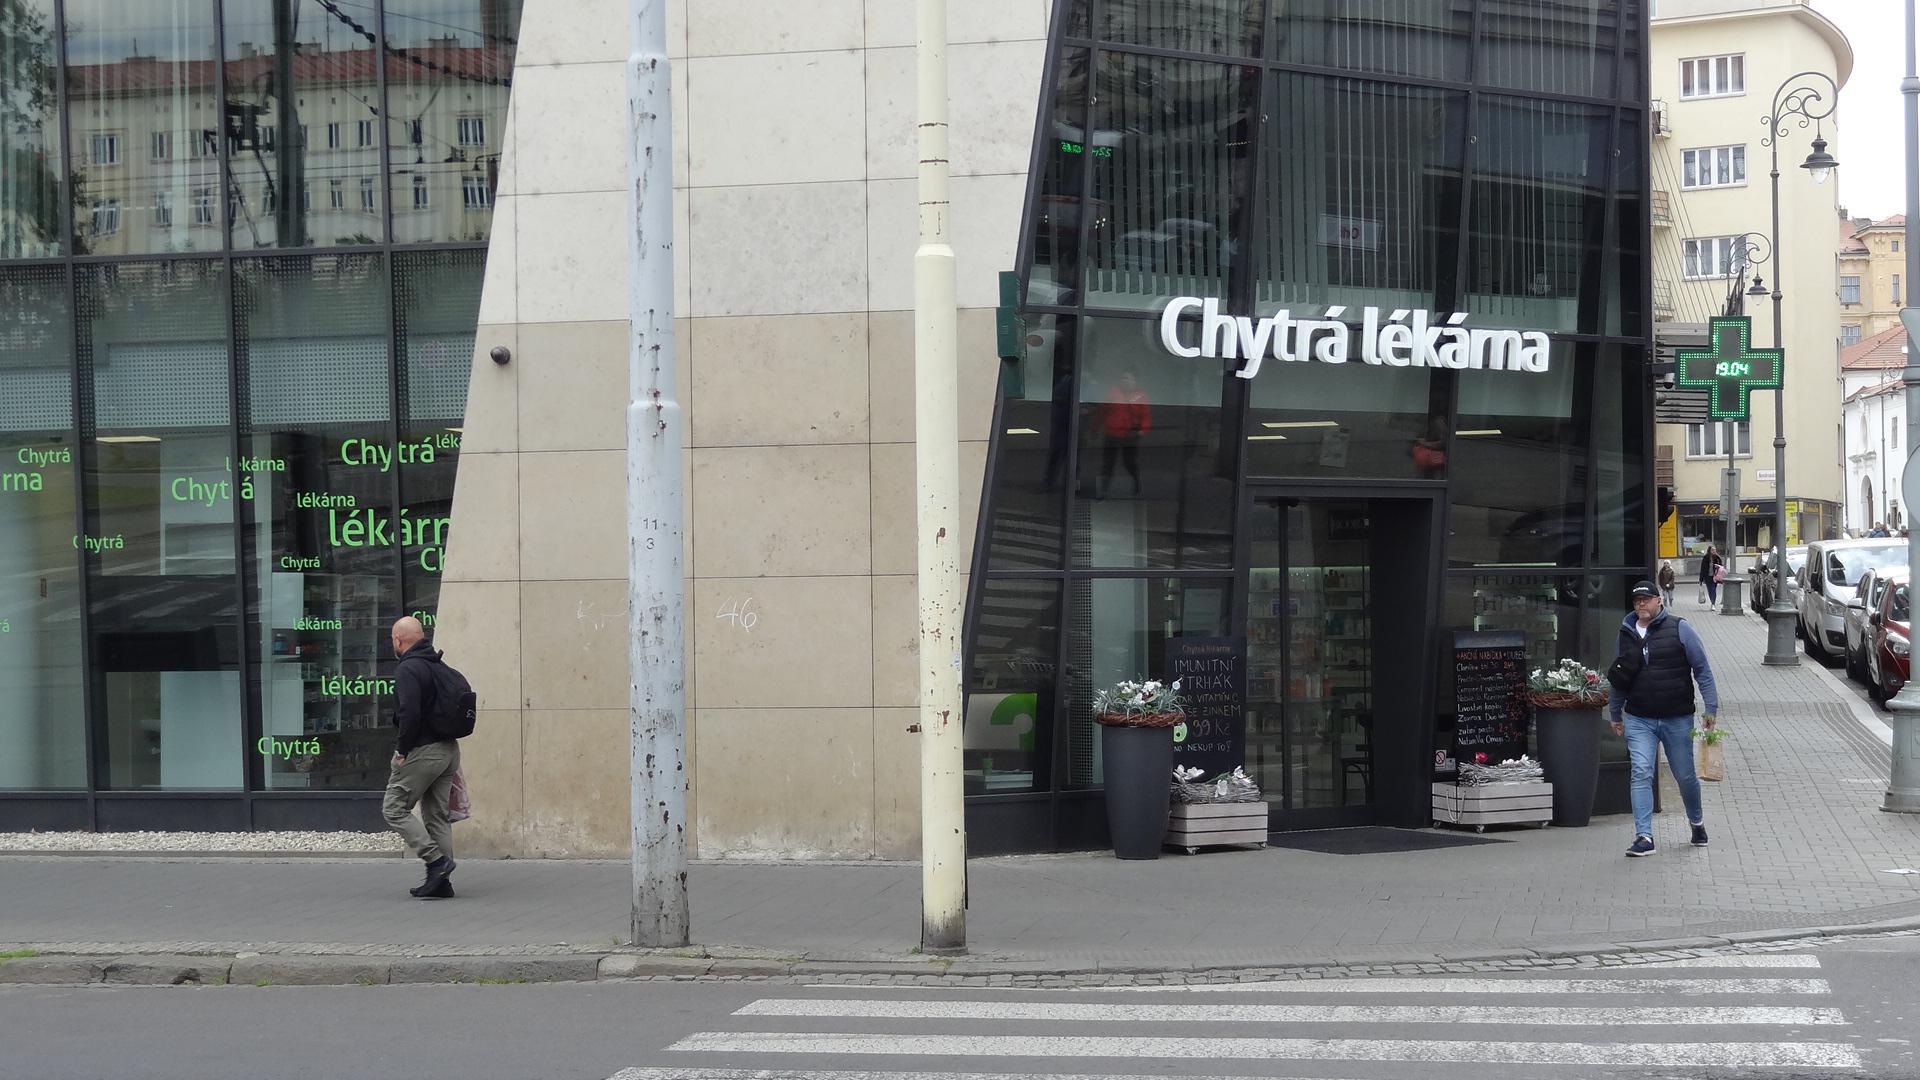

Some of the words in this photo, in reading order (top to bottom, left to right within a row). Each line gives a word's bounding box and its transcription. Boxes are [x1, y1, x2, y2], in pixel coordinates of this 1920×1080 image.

[1160, 296, 1347, 379] Chytrá
[1361, 306, 1550, 372] lékárna
[1715, 361, 1749, 376] 19.04
[436, 434, 462, 448] lék
[18, 448, 71, 467] Chytrá
[341, 437, 435, 472] Chytrá
[225, 456, 285, 472] lkárna
[171, 476, 254, 507] Chytá
[297, 492, 356, 508] lékárna
[643, 517, 659, 531] 11
[646, 537, 656, 550] 3
[280, 556, 321, 571] Chytrá
[716, 597, 757, 633] 46
[293, 617, 343, 631] lékárna
[1174, 656, 1237, 673] IMUNITNÍ
[1185, 673, 1233, 690] TRHÁK
[257, 737, 321, 760] Chytrá
